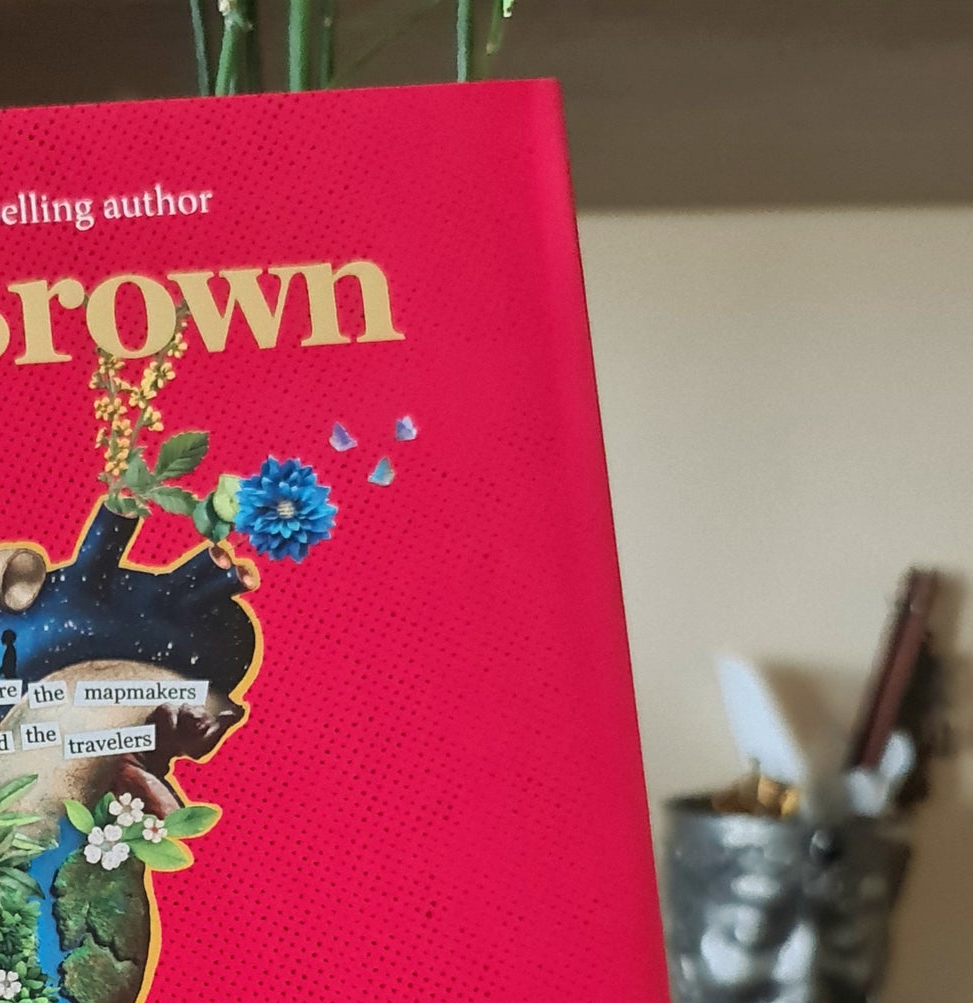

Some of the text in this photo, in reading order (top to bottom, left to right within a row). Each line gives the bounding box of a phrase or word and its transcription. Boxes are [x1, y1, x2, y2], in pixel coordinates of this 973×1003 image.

[103, 185, 214, 221] author
[34, 685, 64, 703] the
[84, 682, 197, 703] mapmakers
[26, 726, 56, 743] the
[68, 731, 152, 755] travelers
